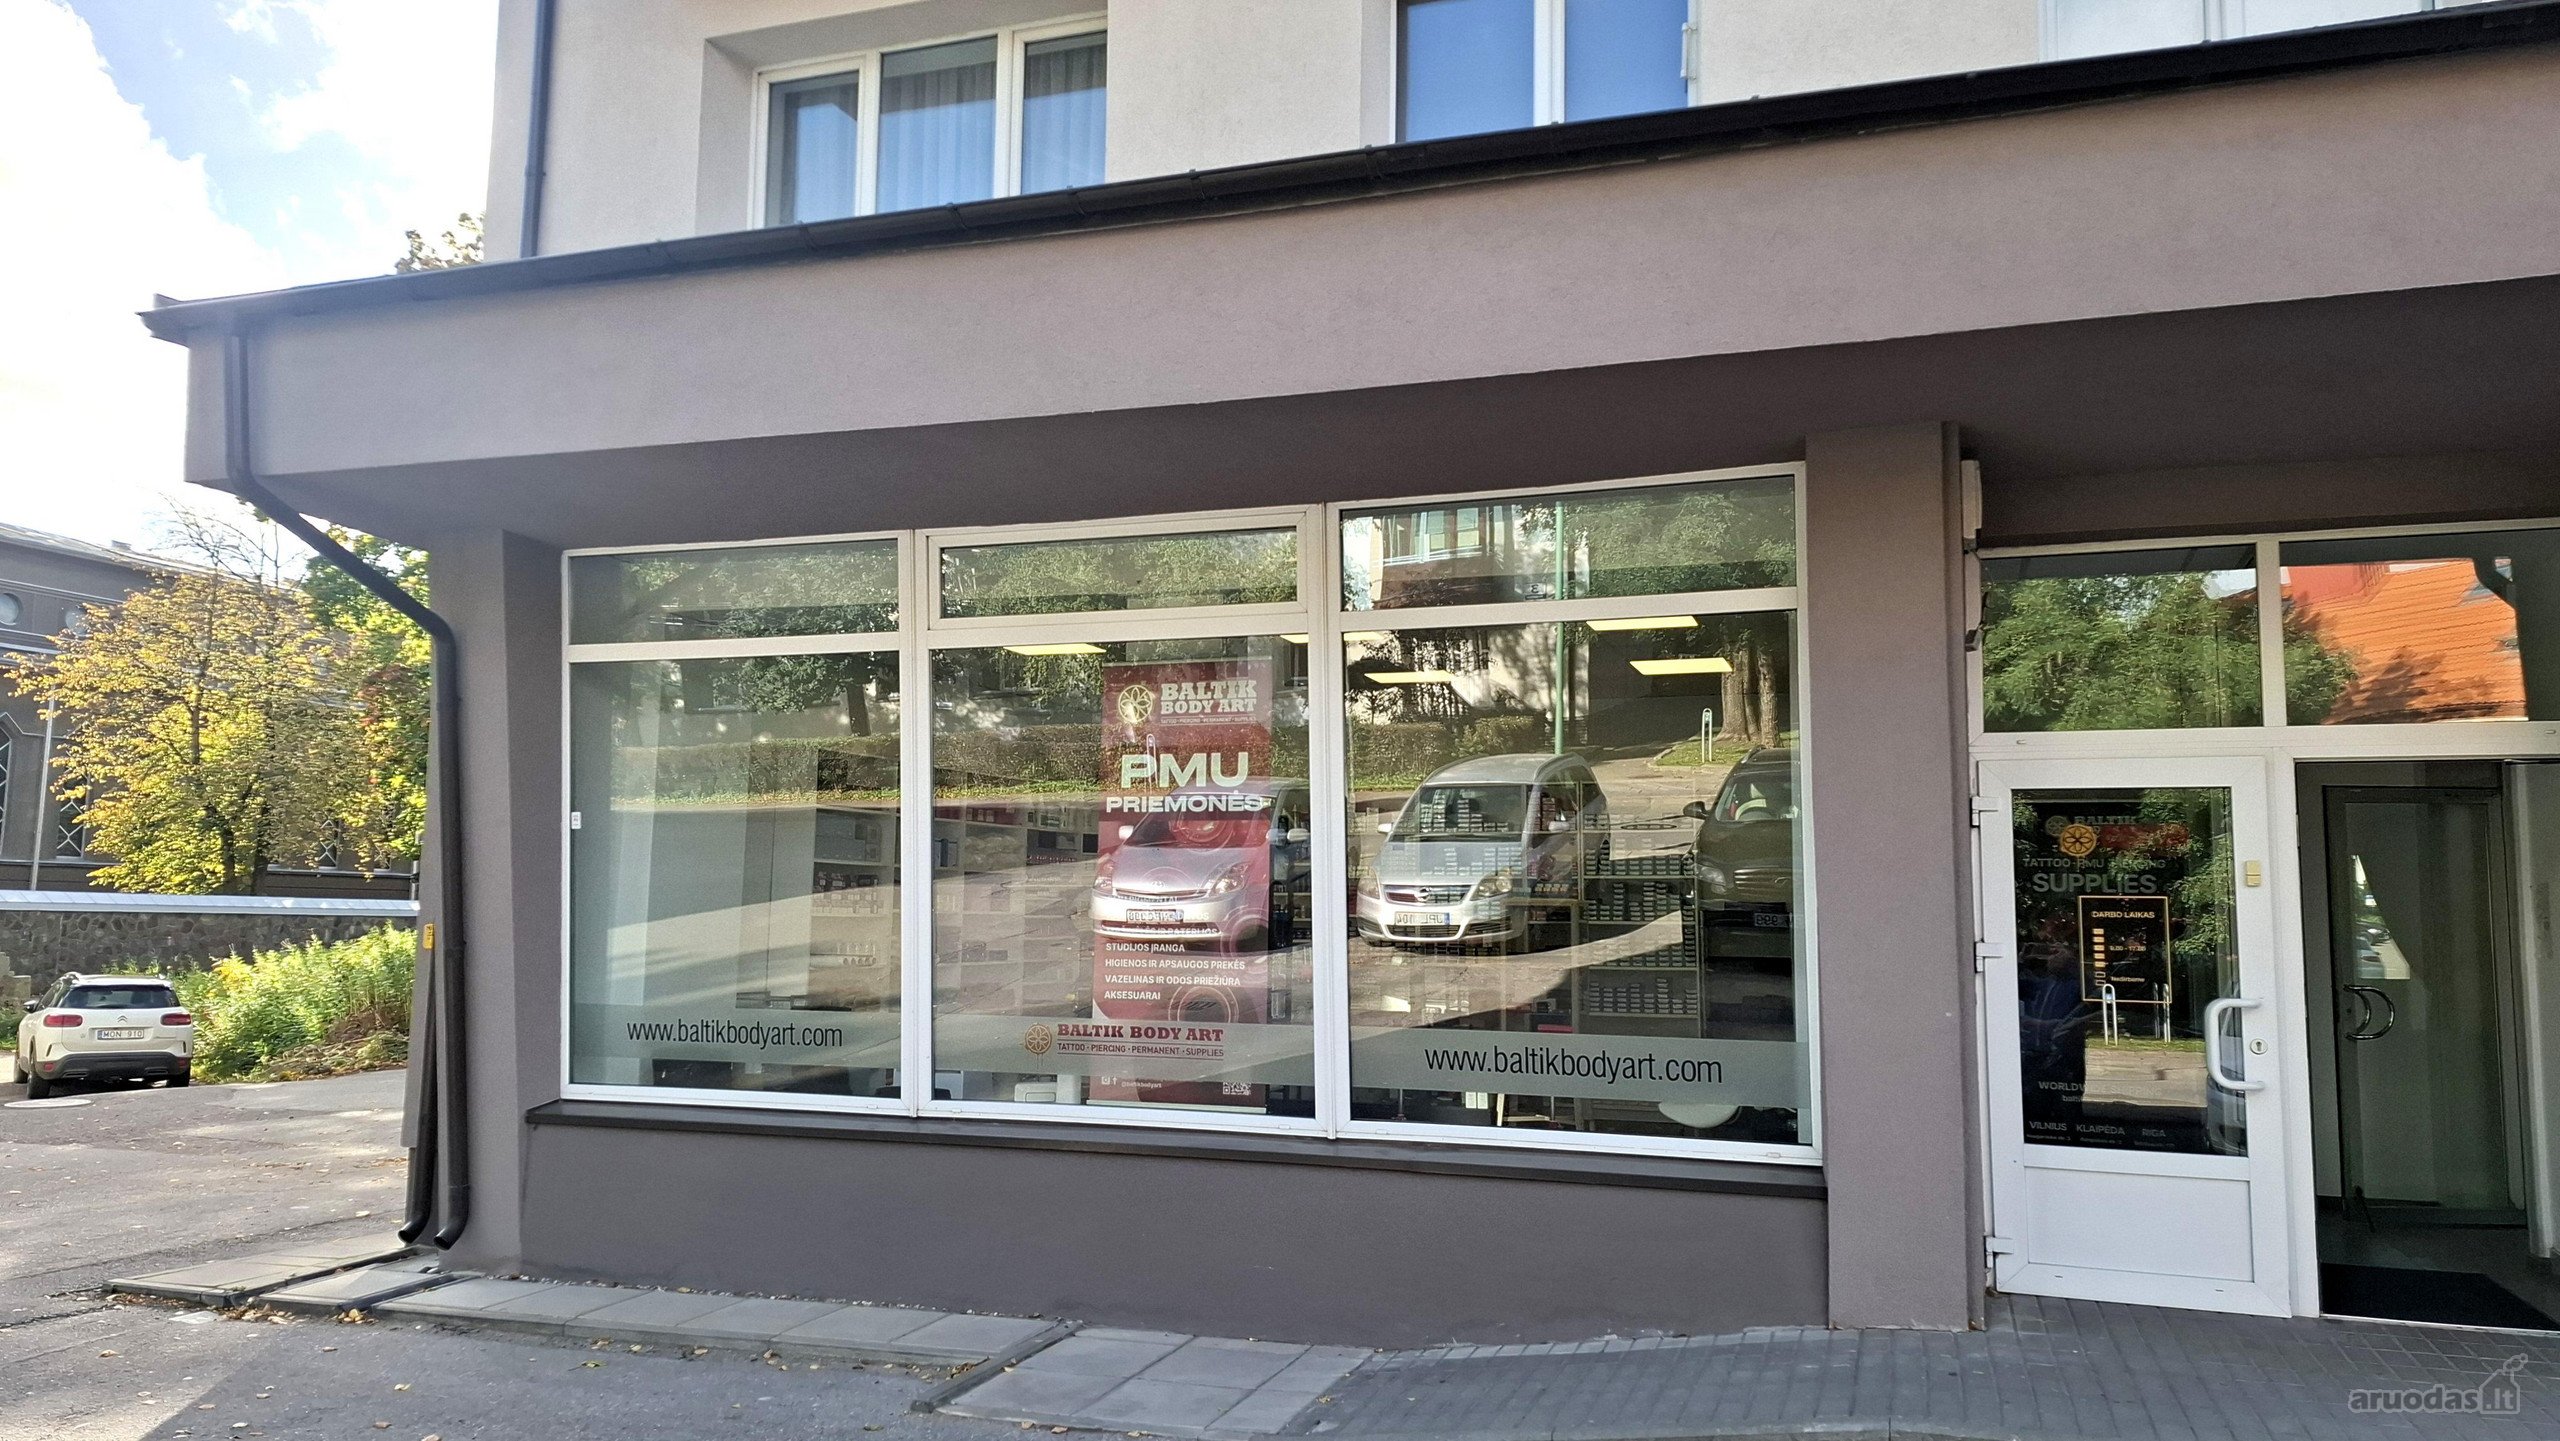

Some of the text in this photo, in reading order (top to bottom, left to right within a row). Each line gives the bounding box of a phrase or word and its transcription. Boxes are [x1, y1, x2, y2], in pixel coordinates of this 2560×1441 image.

[1160, 680, 1257, 700] BALTIK
[1160, 698, 1257, 715] BODY ART
[1121, 752, 1249, 789] PMU
[1106, 790, 1264, 813] PRIEMONĖS
[2022, 858, 2071, 868] TATTOO
[2032, 872, 2158, 894] SUPPLIES
[2124, 911, 2155, 919] LAIKAS
[1106, 943, 1185, 953] STUDIJOS ĮRANGA
[1105, 959, 1245, 970] HIGIENOS IR APSAUGOS PREKĖS
[1105, 974, 1241, 986] VAZELINAS IR ODOS PRIEŽIŪRA
[1104, 990, 1160, 1000] AKSESUARAI
[627, 1019, 843, 1050] www.baltikbodyart.com
[1057, 1023, 1223, 1042] BALTIK BODY ART
[1057, 1043, 1224, 1057] TATTOO PIERCING PERMANENT SUPPLIES
[1424, 1045, 1722, 1084] www.baltikbodyart.com
[2029, 1120, 2068, 1131] VILNIUS
